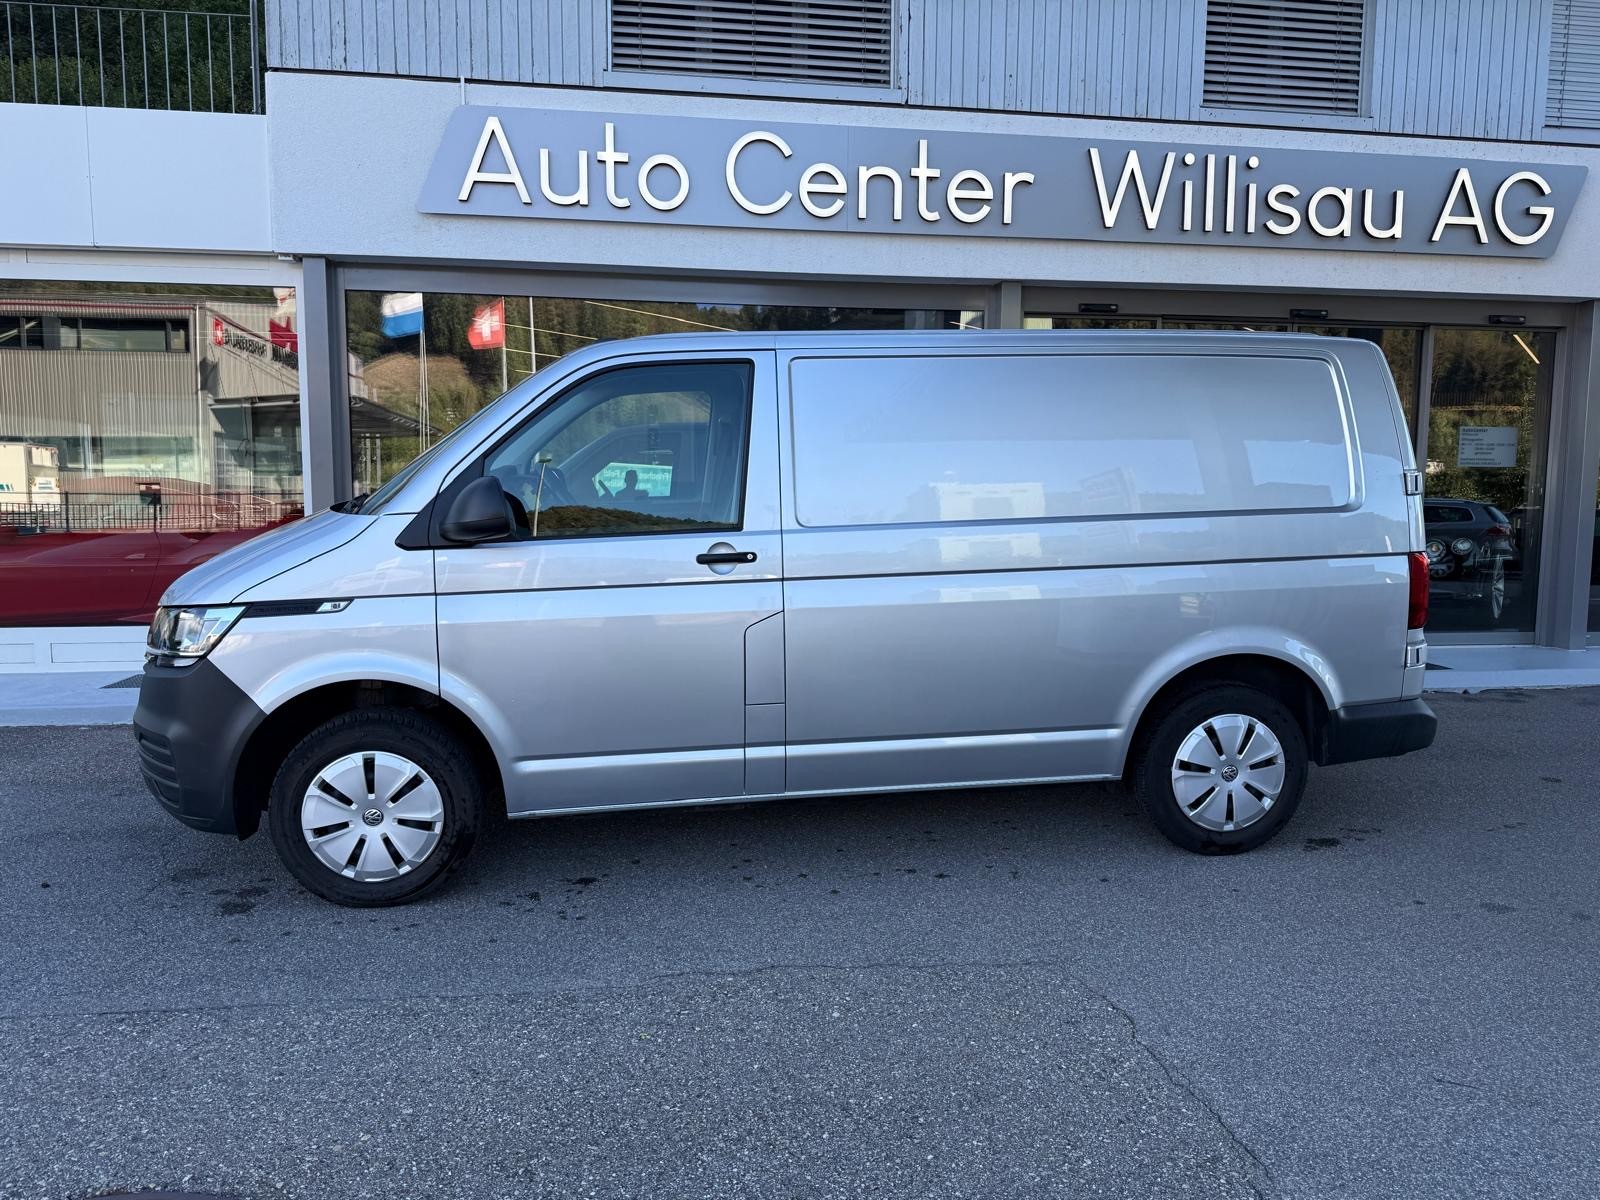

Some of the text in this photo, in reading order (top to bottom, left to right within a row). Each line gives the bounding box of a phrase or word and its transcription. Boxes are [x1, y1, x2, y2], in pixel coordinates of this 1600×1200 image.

[457, 115, 1557, 246] Auto Center Willisau AG
